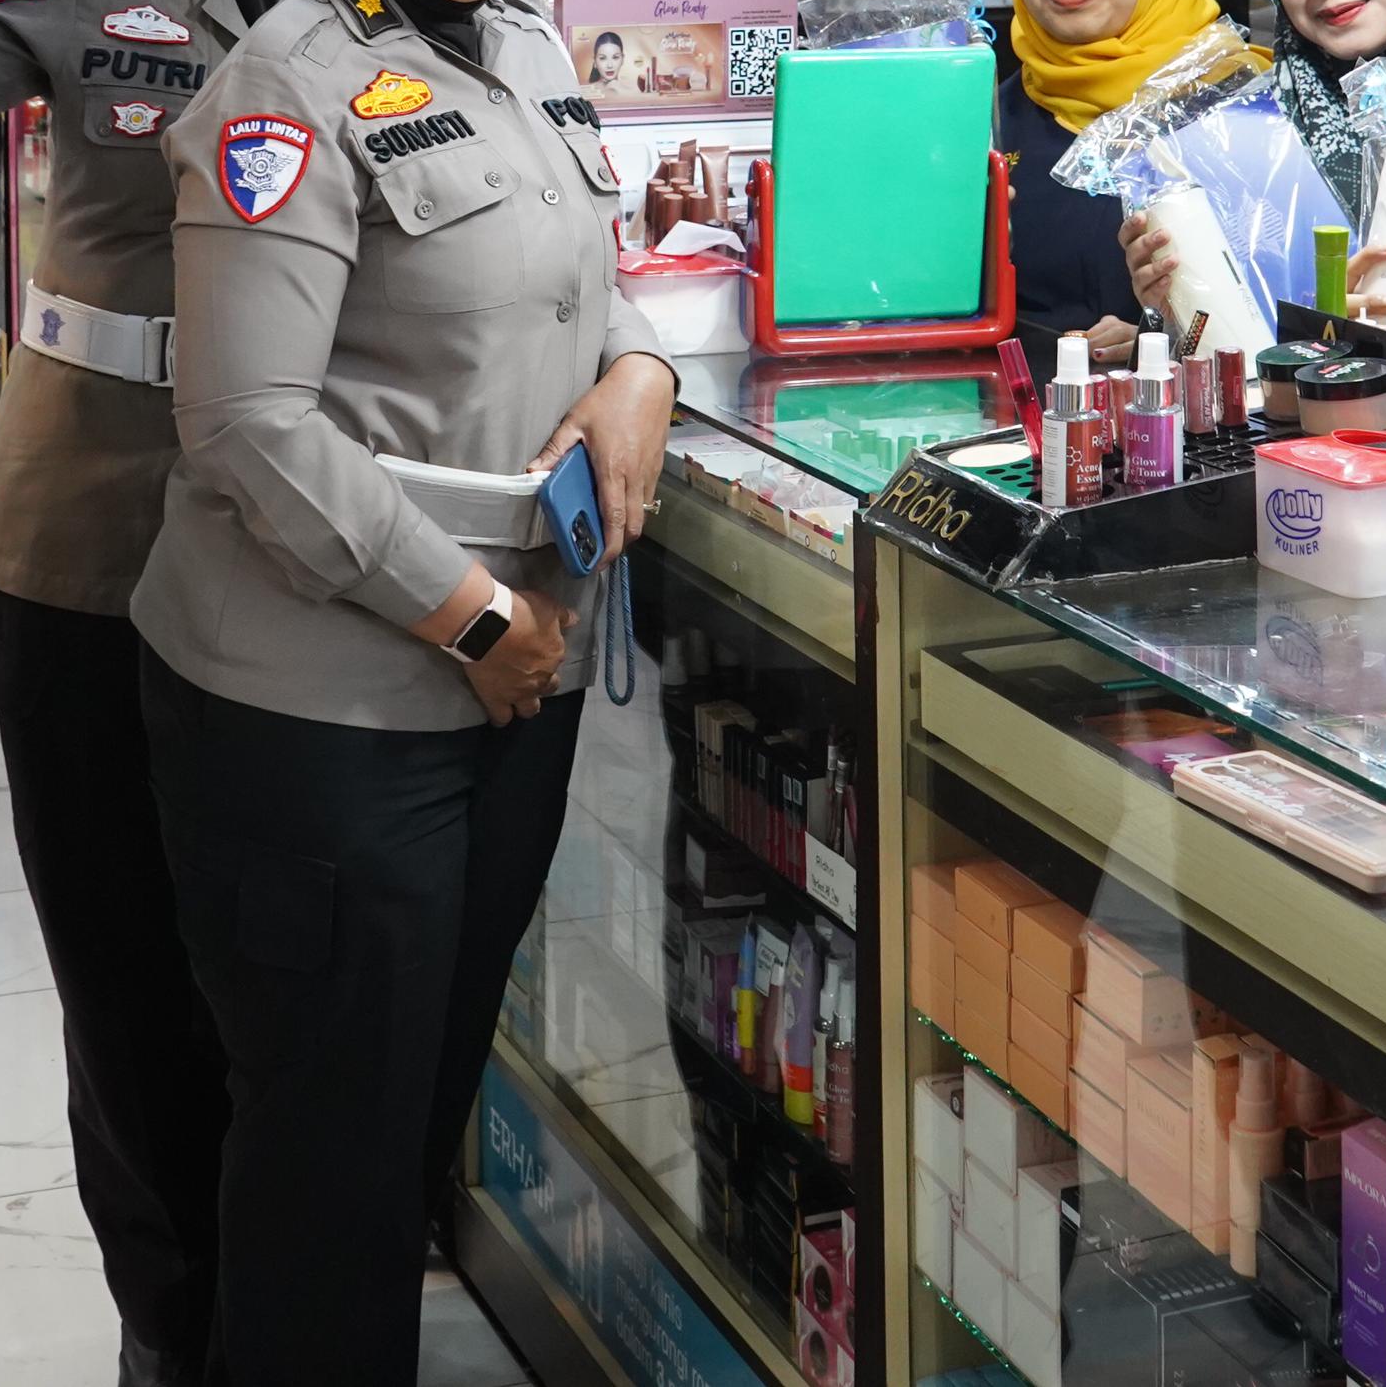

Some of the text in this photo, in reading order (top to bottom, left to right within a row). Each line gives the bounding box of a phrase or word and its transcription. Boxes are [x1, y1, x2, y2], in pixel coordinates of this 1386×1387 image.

[653, 0, 679, 18] Glow
[681, 0, 710, 20] Ready
[80, 46, 207, 91] PUTRI
[228, 120, 309, 145] LALU LINTAS
[364, 109, 476, 164] SUNARTI
[1131, 456, 1157, 467] Glow
[1138, 467, 1168, 479] Toner
[890, 470, 973, 542] Ridha
[1273, 488, 1323, 522] Jolly
[1274, 535, 1320, 556] KULINER
